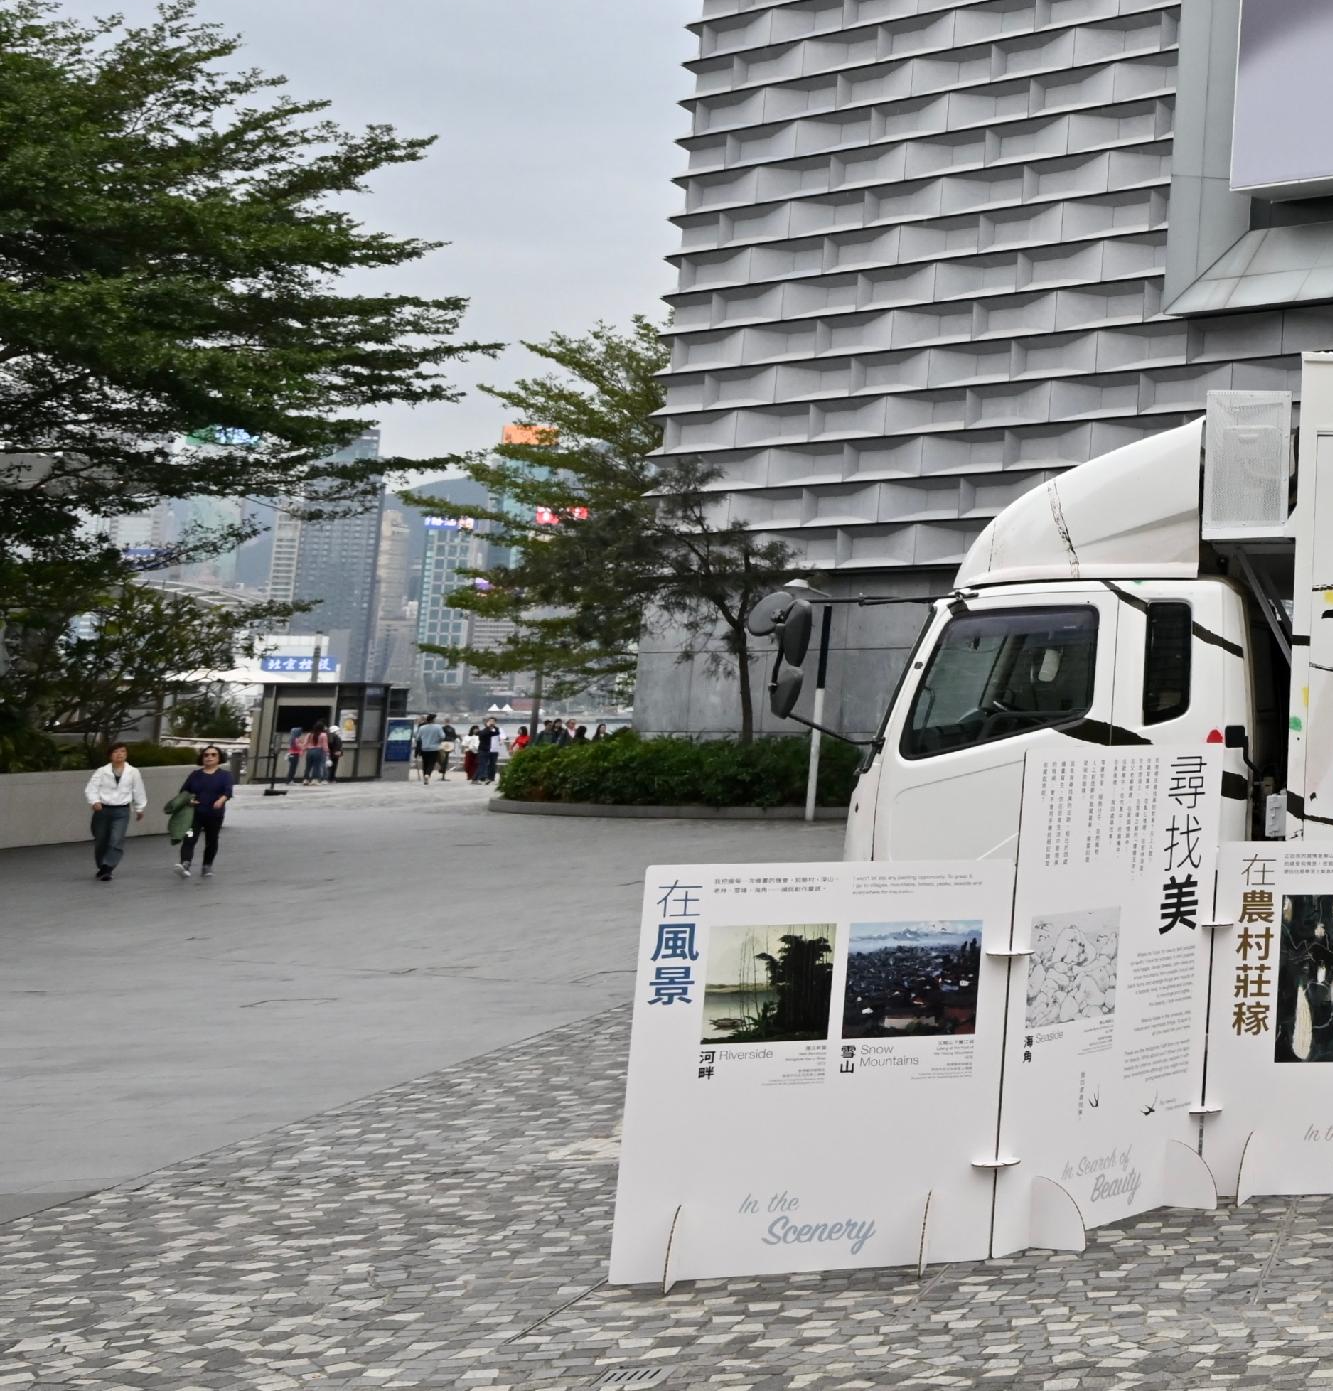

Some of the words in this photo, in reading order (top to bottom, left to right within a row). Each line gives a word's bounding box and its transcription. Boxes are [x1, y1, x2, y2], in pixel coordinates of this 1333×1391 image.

[1158, 755, 1207, 935] 尋找美
[647, 879, 702, 1005] 在風景
[1232, 853, 1276, 1036] 在農村莊稼
[719, 1048, 774, 1061] Riverside
[839, 1045, 857, 1074] 雪山
[859, 1055, 919, 1067] Mountains
[860, 1044, 894, 1055] Snow
[698, 1050, 716, 1080] 河畔
[1303, 1123, 1320, 1142] In
[1061, 1159, 1074, 1180] In
[1076, 1147, 1117, 1176] Search
[1120, 1143, 1132, 1171] of
[1090, 1167, 1142, 1206] Beauty
[738, 1193, 759, 1214] In
[767, 1190, 799, 1213] the
[761, 1215, 876, 1255] Scenery
